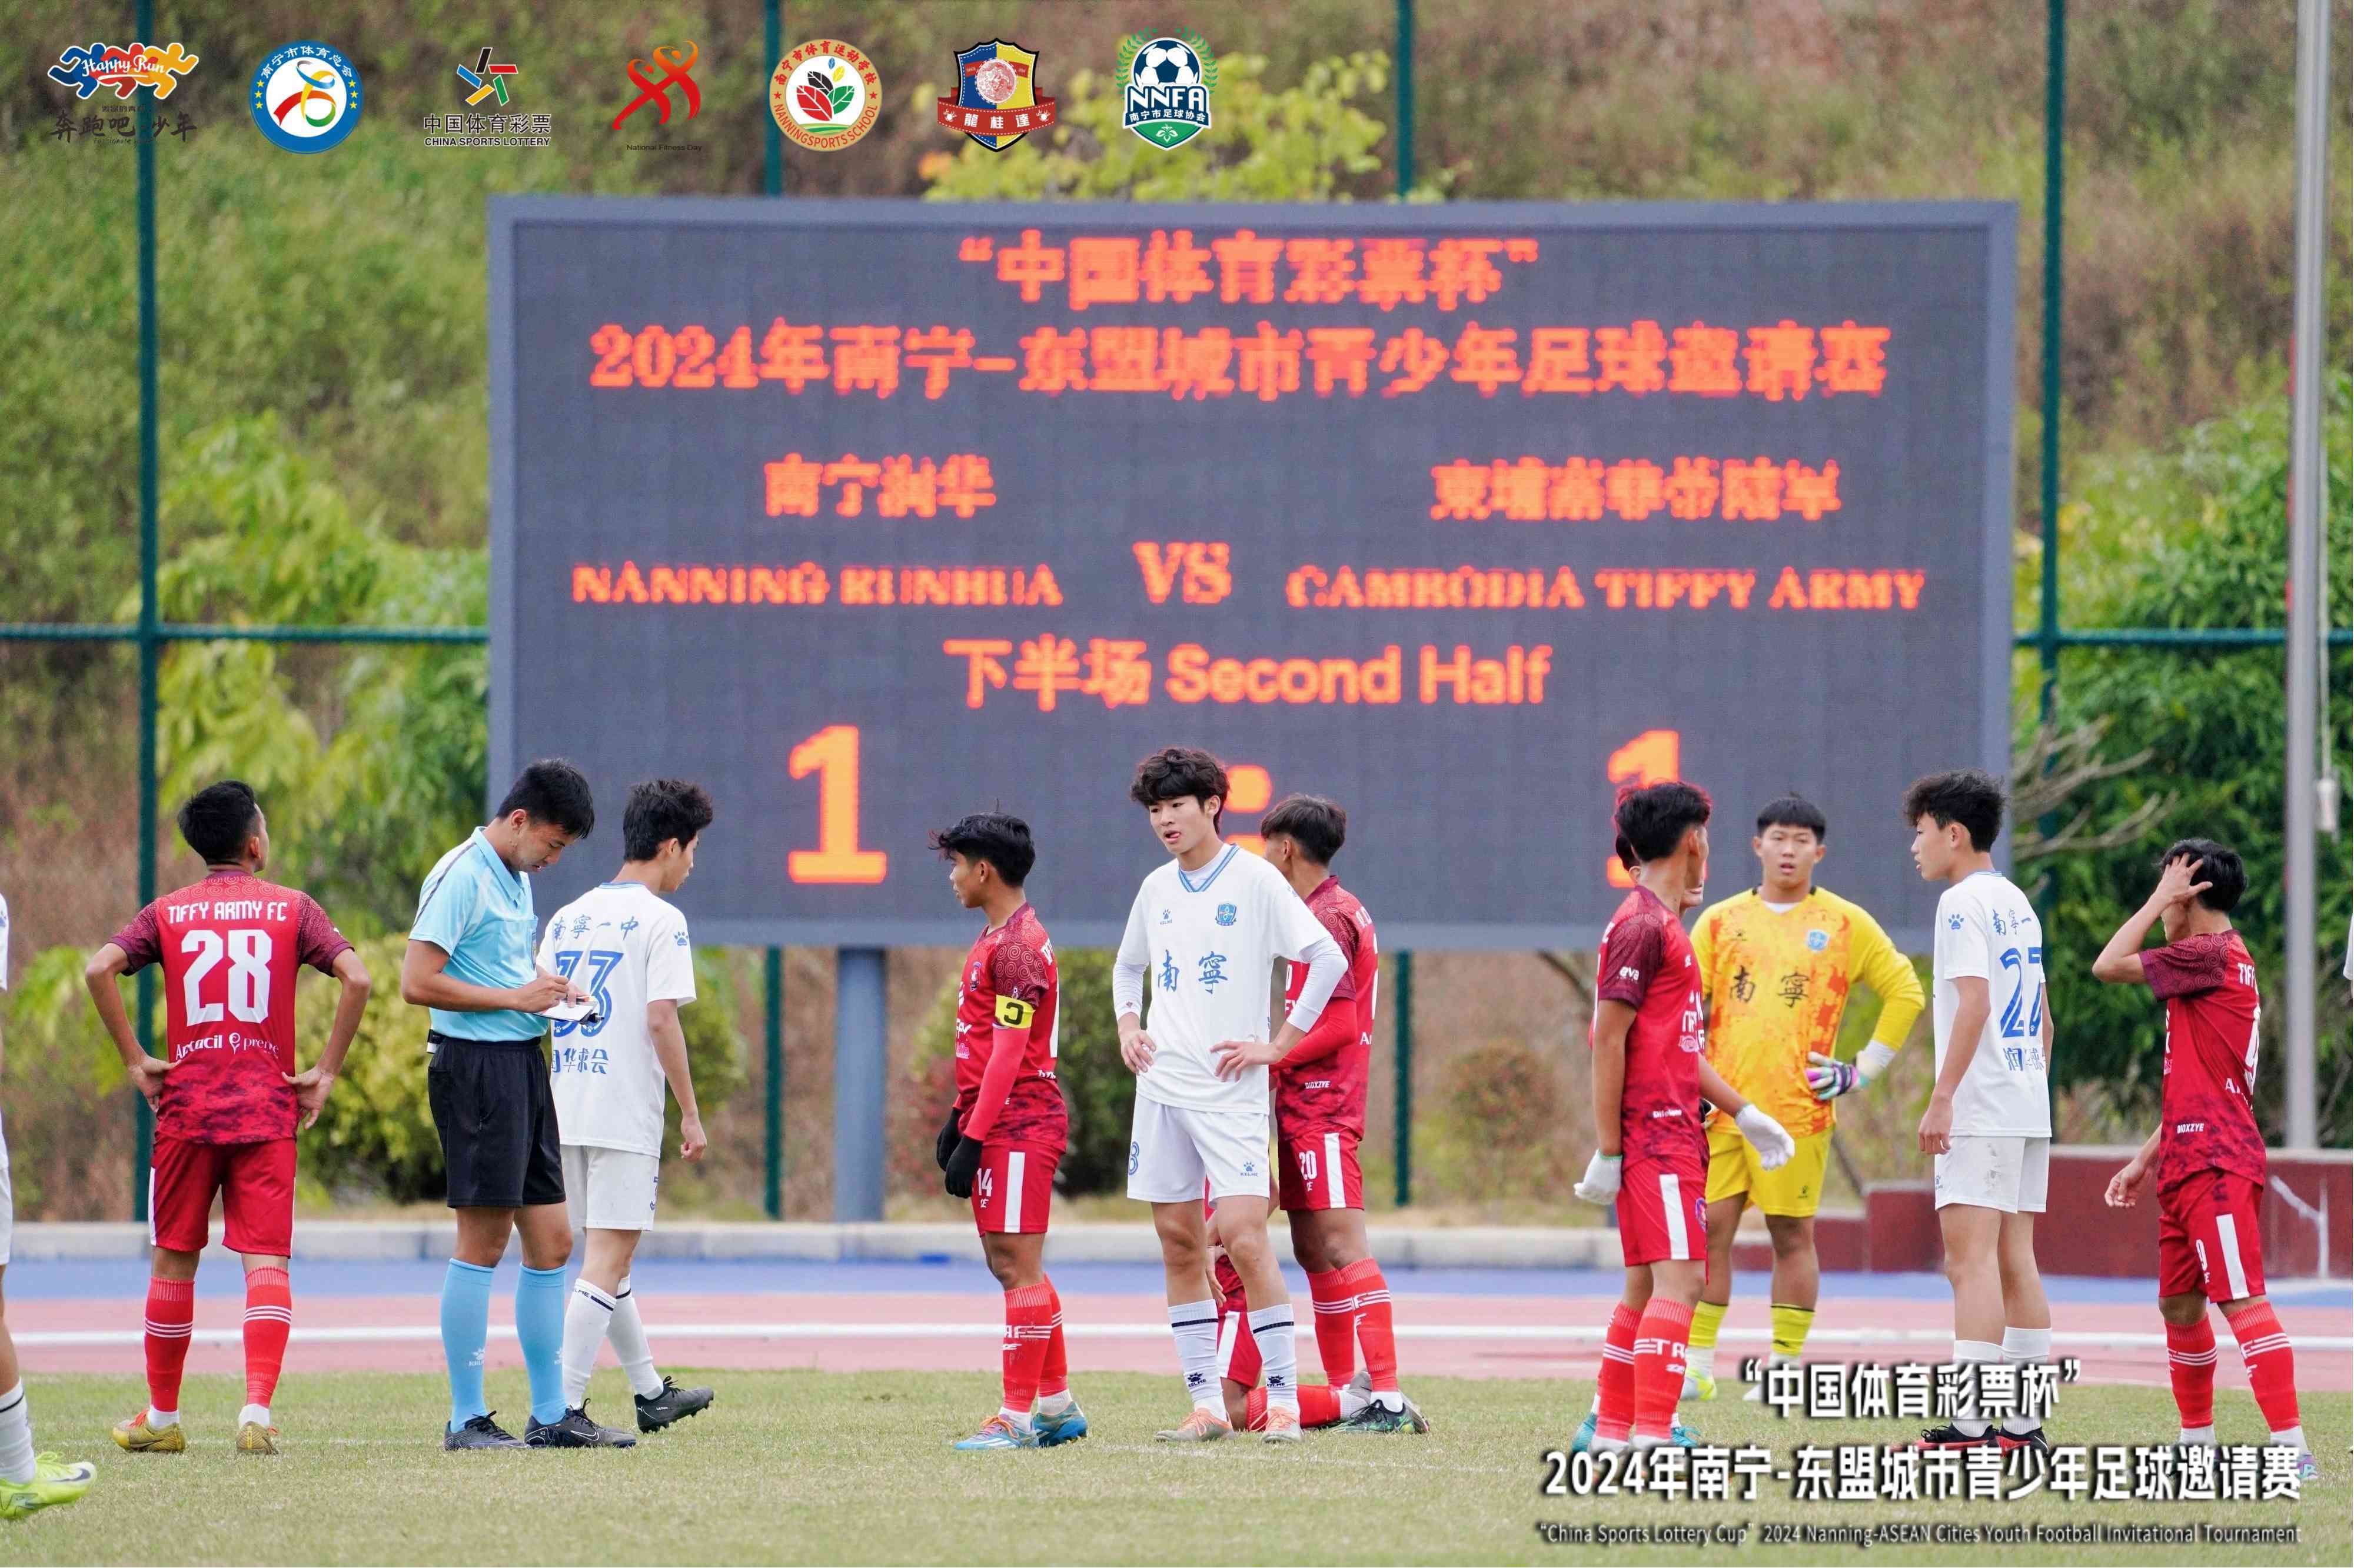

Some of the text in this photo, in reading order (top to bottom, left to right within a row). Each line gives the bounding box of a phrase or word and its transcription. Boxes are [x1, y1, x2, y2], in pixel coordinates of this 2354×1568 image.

[573, 561, 830, 605] NANNING
[1132, 541, 1232, 604] VS
[943, 633, 1152, 712] 下半场
[1165, 644, 1553, 704] Second Half
[788, 725, 887, 884] 1
[168, 900, 288, 924] TIFFY ARMY FC
[181, 929, 272, 1027] 28
[977, 1167, 993, 1197] 14
[1299, 1150, 1318, 1180] 20
[2196, 1239, 2207, 1271] 9
